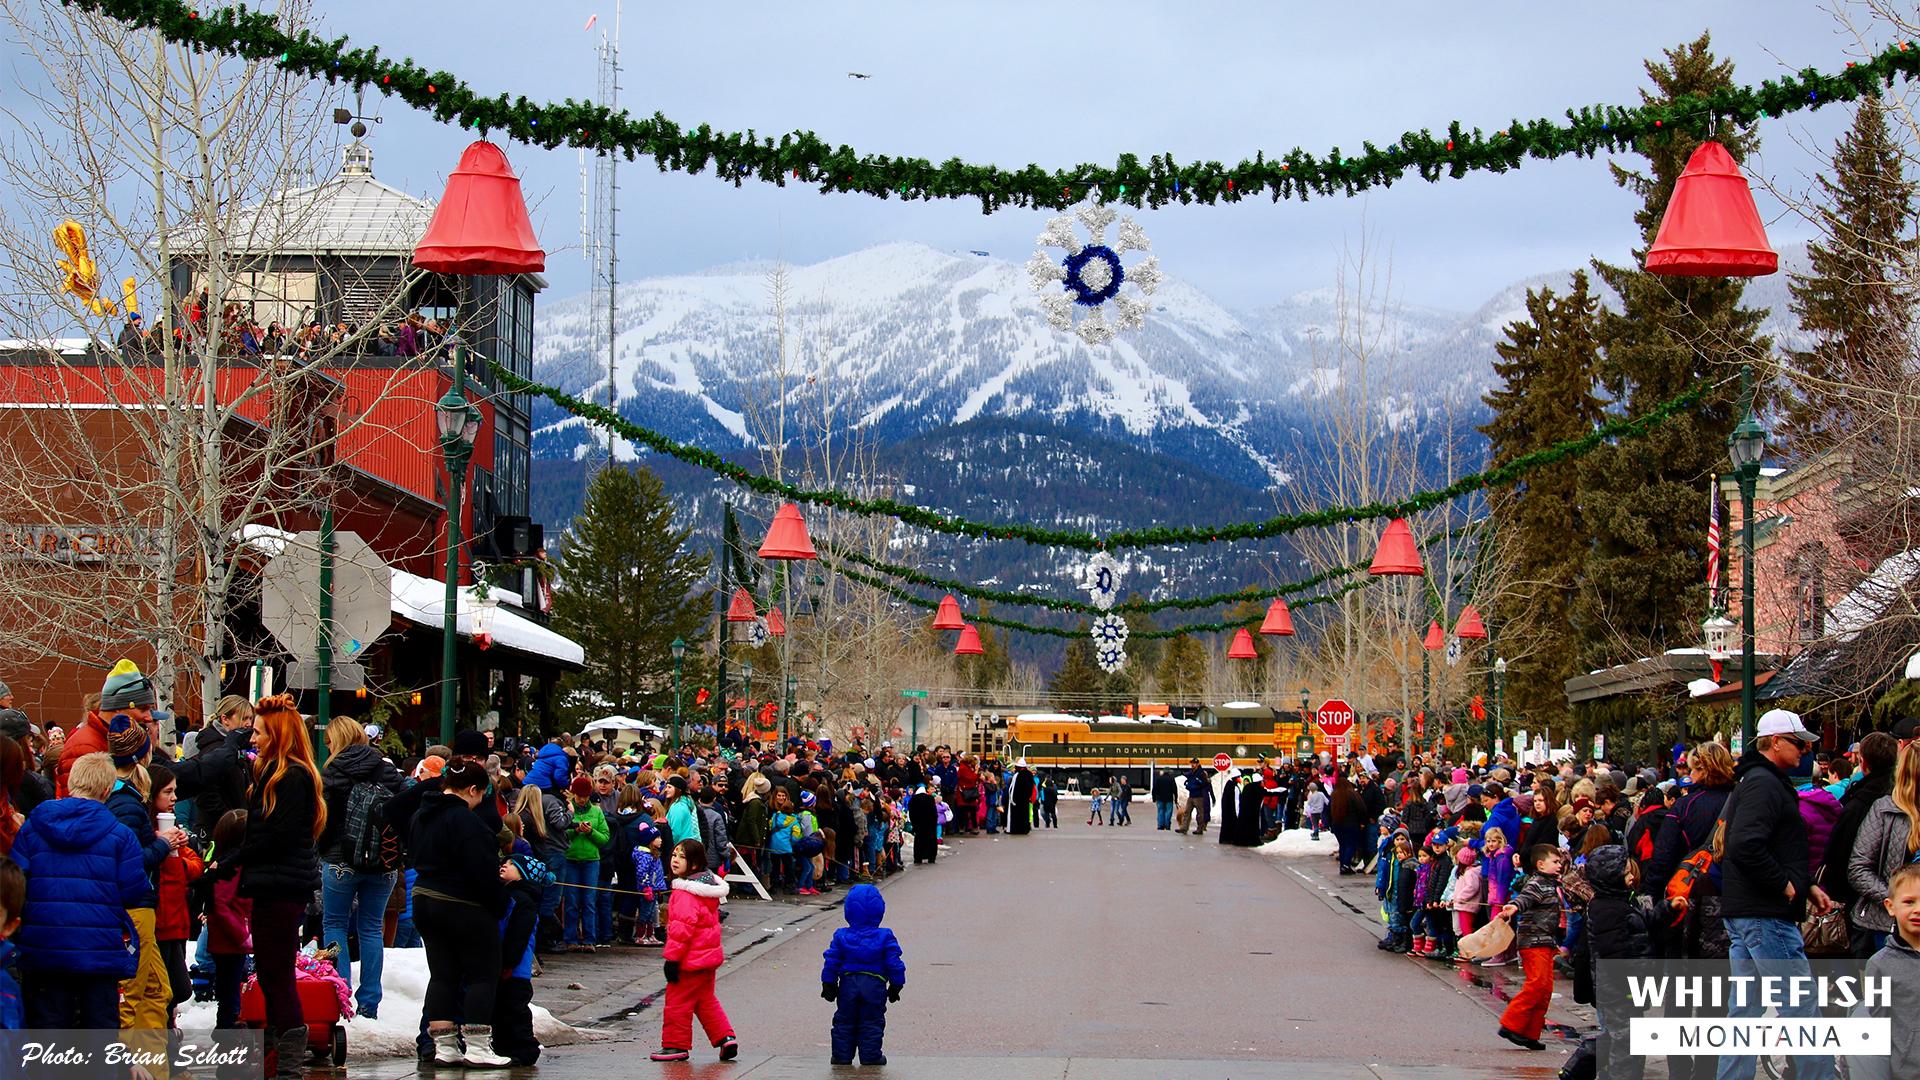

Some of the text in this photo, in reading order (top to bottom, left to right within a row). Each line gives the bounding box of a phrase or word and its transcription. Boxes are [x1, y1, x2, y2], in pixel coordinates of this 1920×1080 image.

[1320, 711, 1351, 725] STOP
[1302, 740, 1310, 750] P
[1214, 758, 1230, 767] STOP
